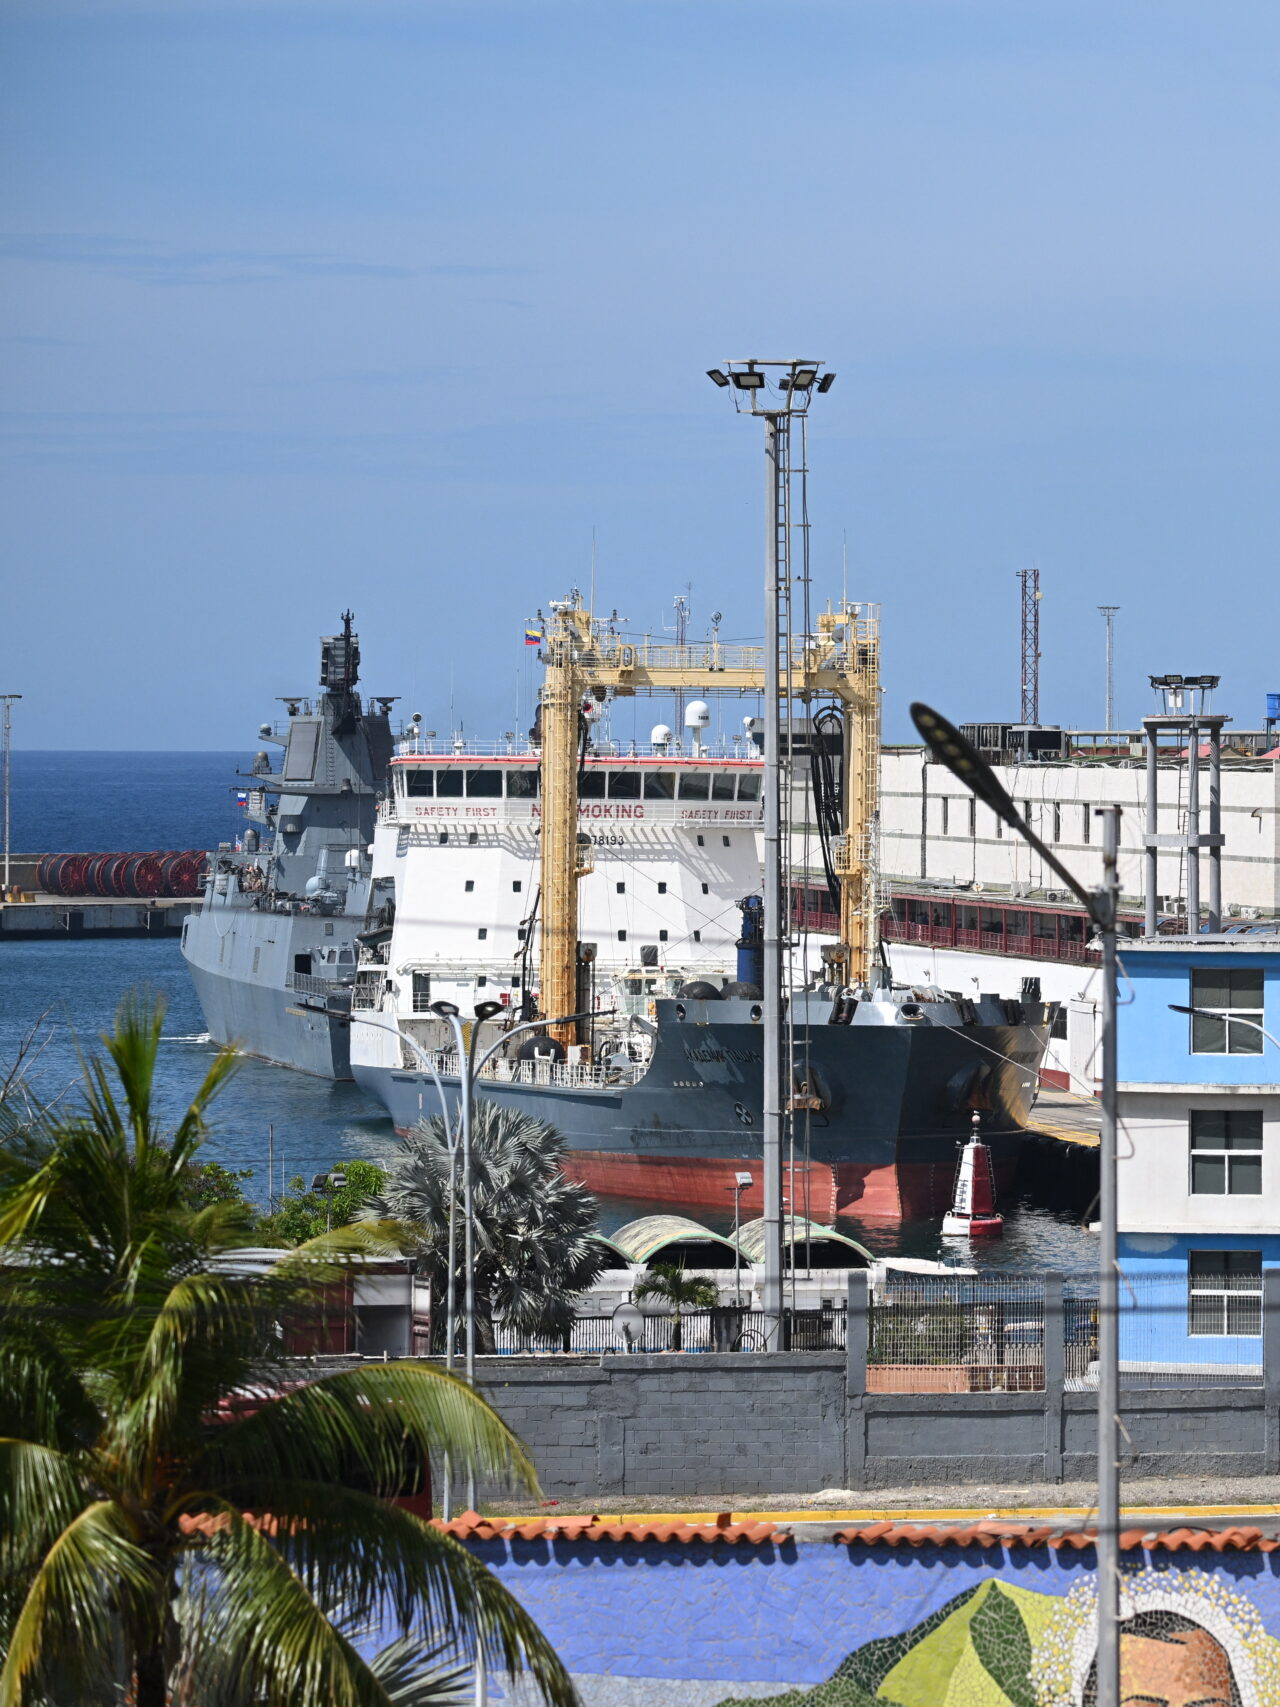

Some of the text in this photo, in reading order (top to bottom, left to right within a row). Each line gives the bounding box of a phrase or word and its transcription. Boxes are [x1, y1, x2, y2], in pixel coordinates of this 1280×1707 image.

[415, 806, 498, 817] SAFETY FIRST
[576, 803, 645, 819] MOKING
[681, 809, 753, 820] SAFETY FIRST
